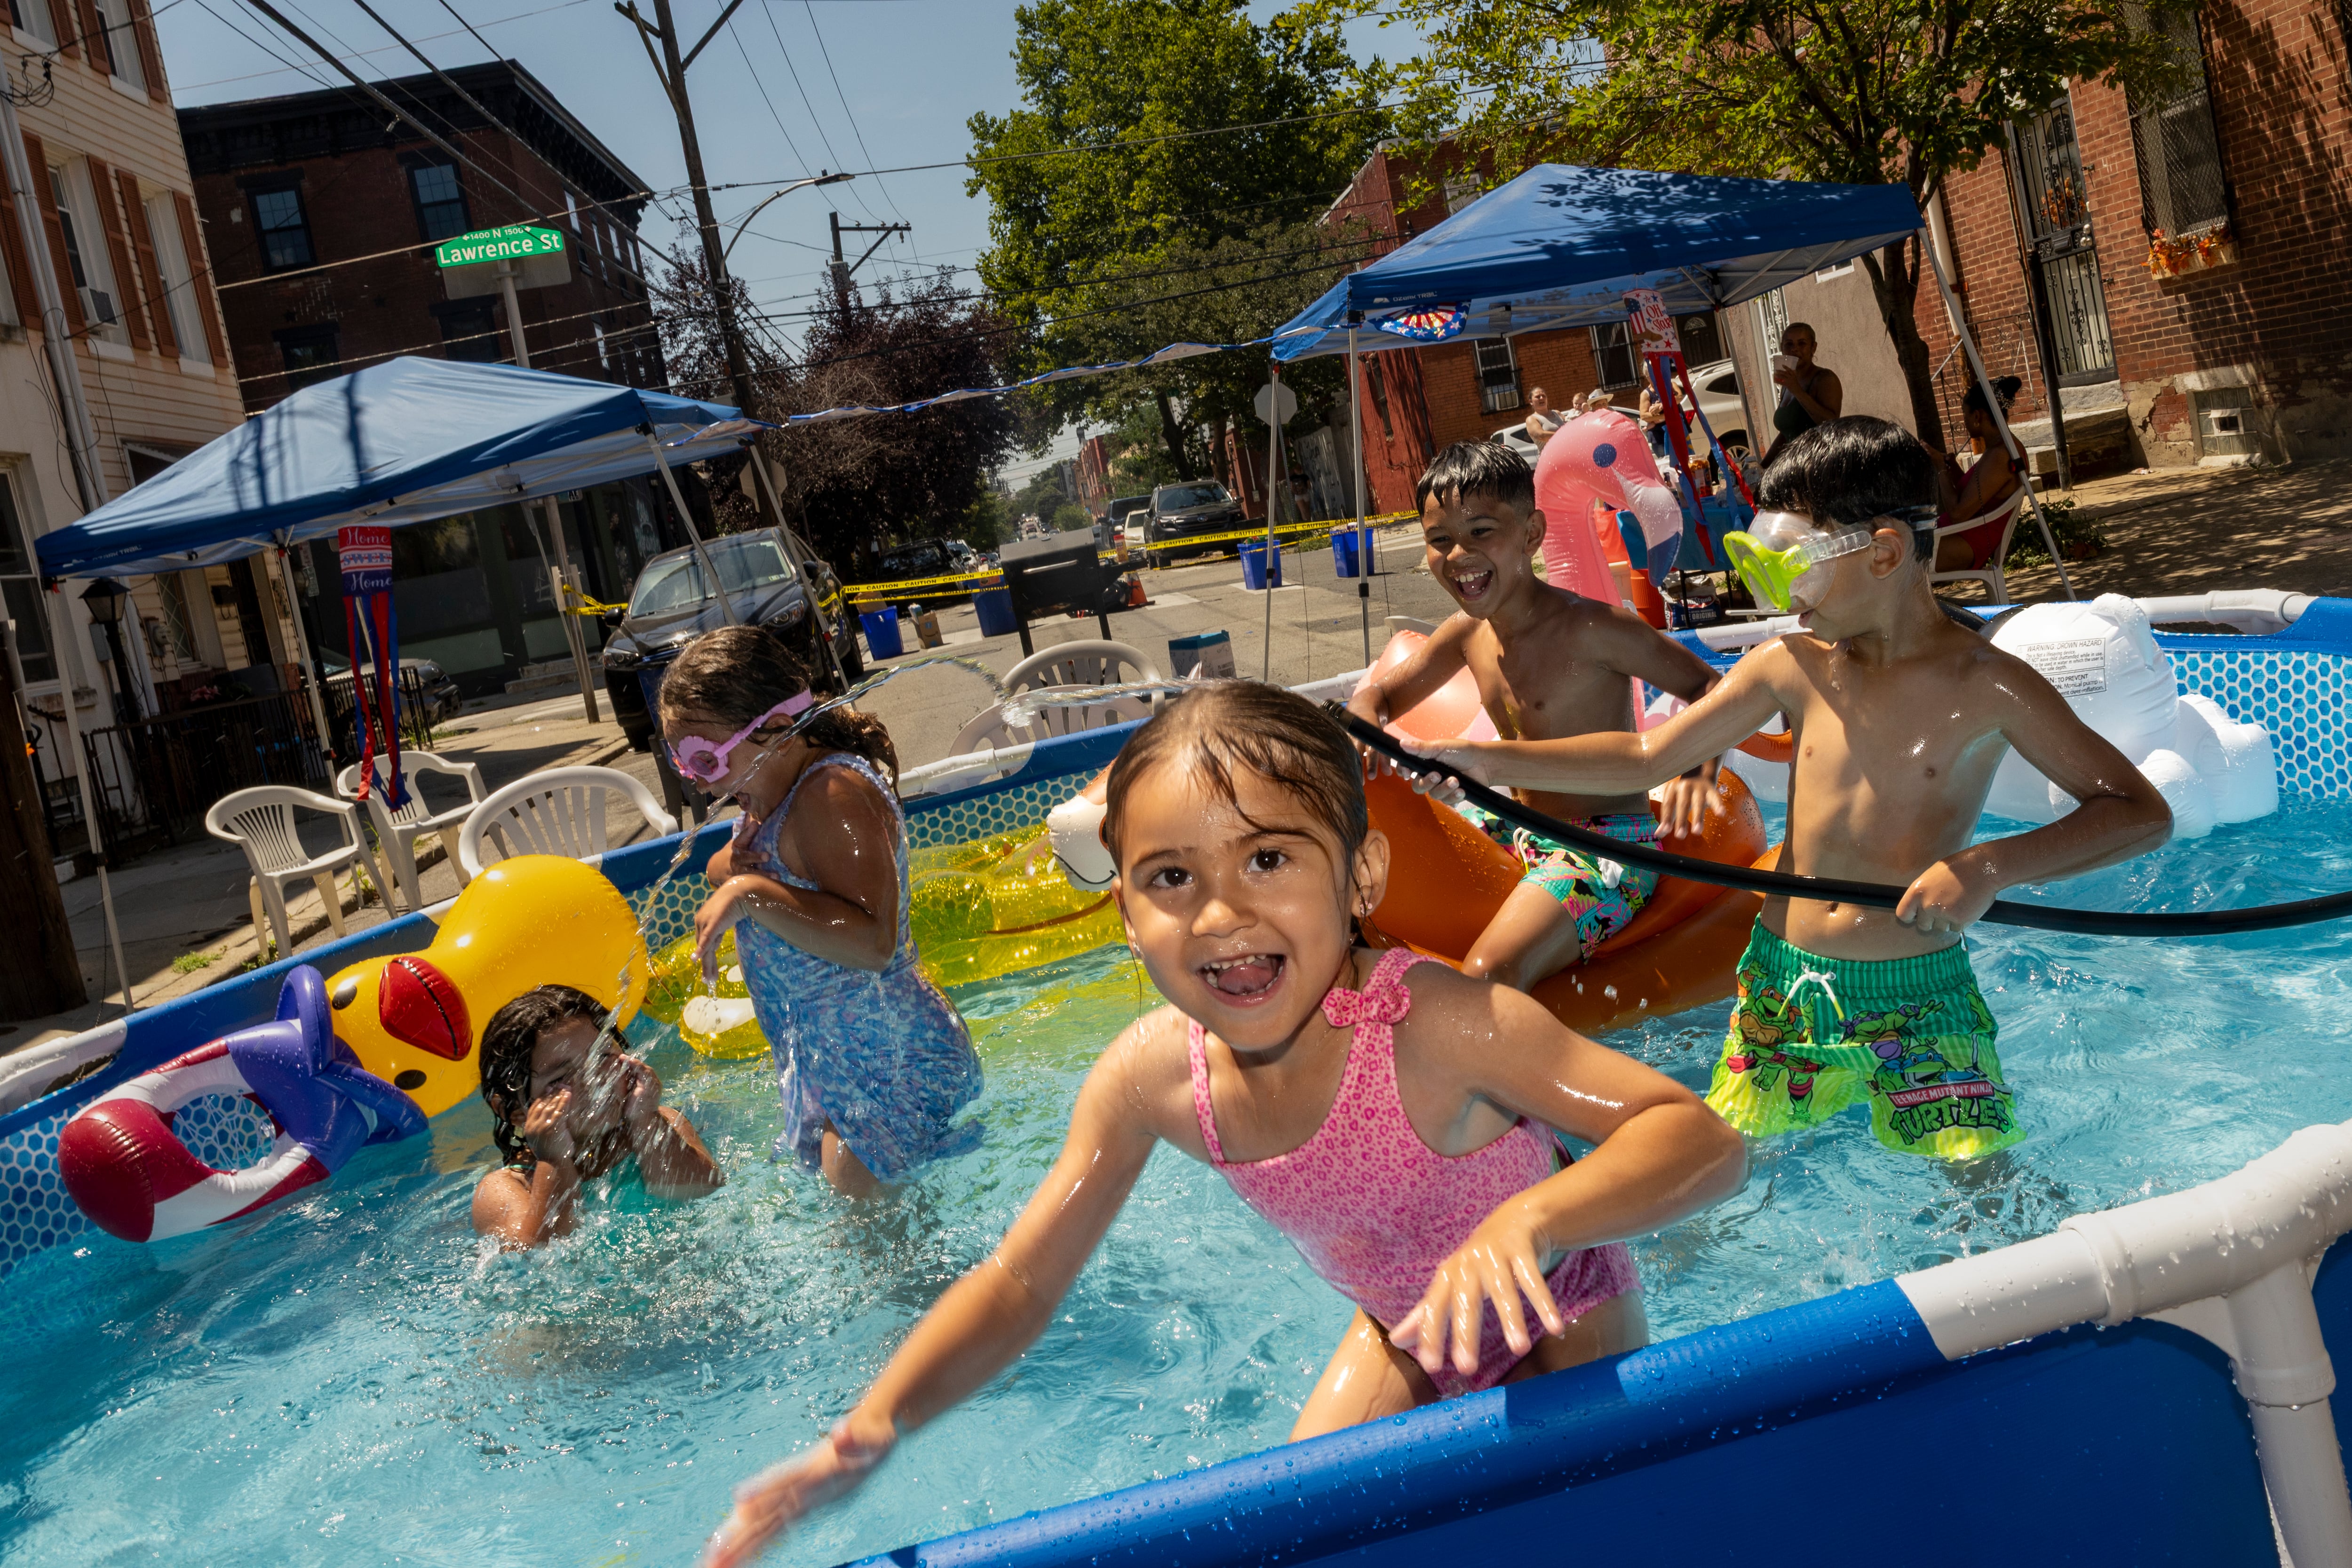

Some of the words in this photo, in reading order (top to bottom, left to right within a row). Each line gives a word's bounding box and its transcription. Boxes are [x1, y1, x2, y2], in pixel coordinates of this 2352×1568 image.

[493, 229, 501, 238] N
[439, 239, 533, 263] Lawrence
[540, 233, 560, 249] St
[1646, 304, 1663, 318] OH
[347, 527, 388, 545] Home
[1164, 538, 1193, 547] CAUTION
[343, 553, 391, 566] SWEE
[351, 572, 393, 591] Home
[1692, 611, 1717, 620] ORIGINAL
[2057, 641, 2077, 650] DROWN
[1890, 1090, 1928, 1105] TEENAGE
[1929, 1086, 1969, 1098] MUTANT
[1971, 1083, 1993, 1095] NINJA
[1889, 1097, 2014, 1146] TURTLES
